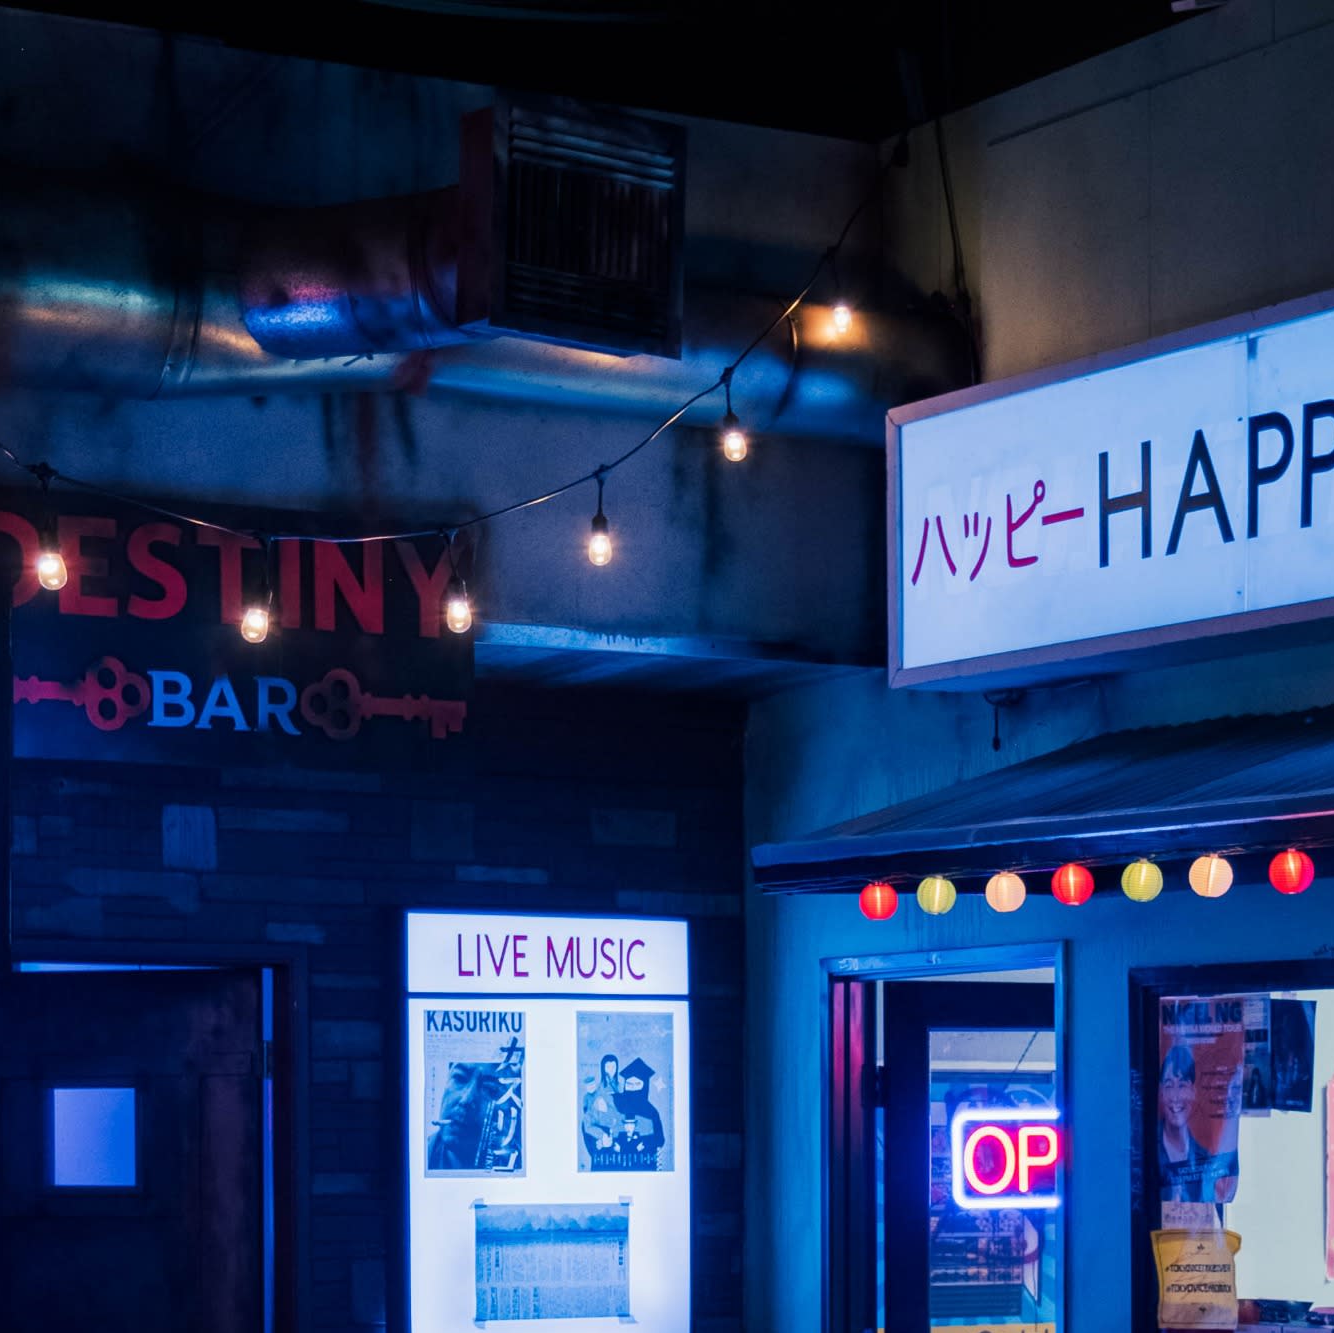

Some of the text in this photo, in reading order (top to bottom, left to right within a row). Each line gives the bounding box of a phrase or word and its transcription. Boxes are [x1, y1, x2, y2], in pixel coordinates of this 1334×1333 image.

[911, 479, 1083, 585] ハッピー
[147, 670, 302, 736] BAR
[457, 934, 647, 981] LIVE MUSIC
